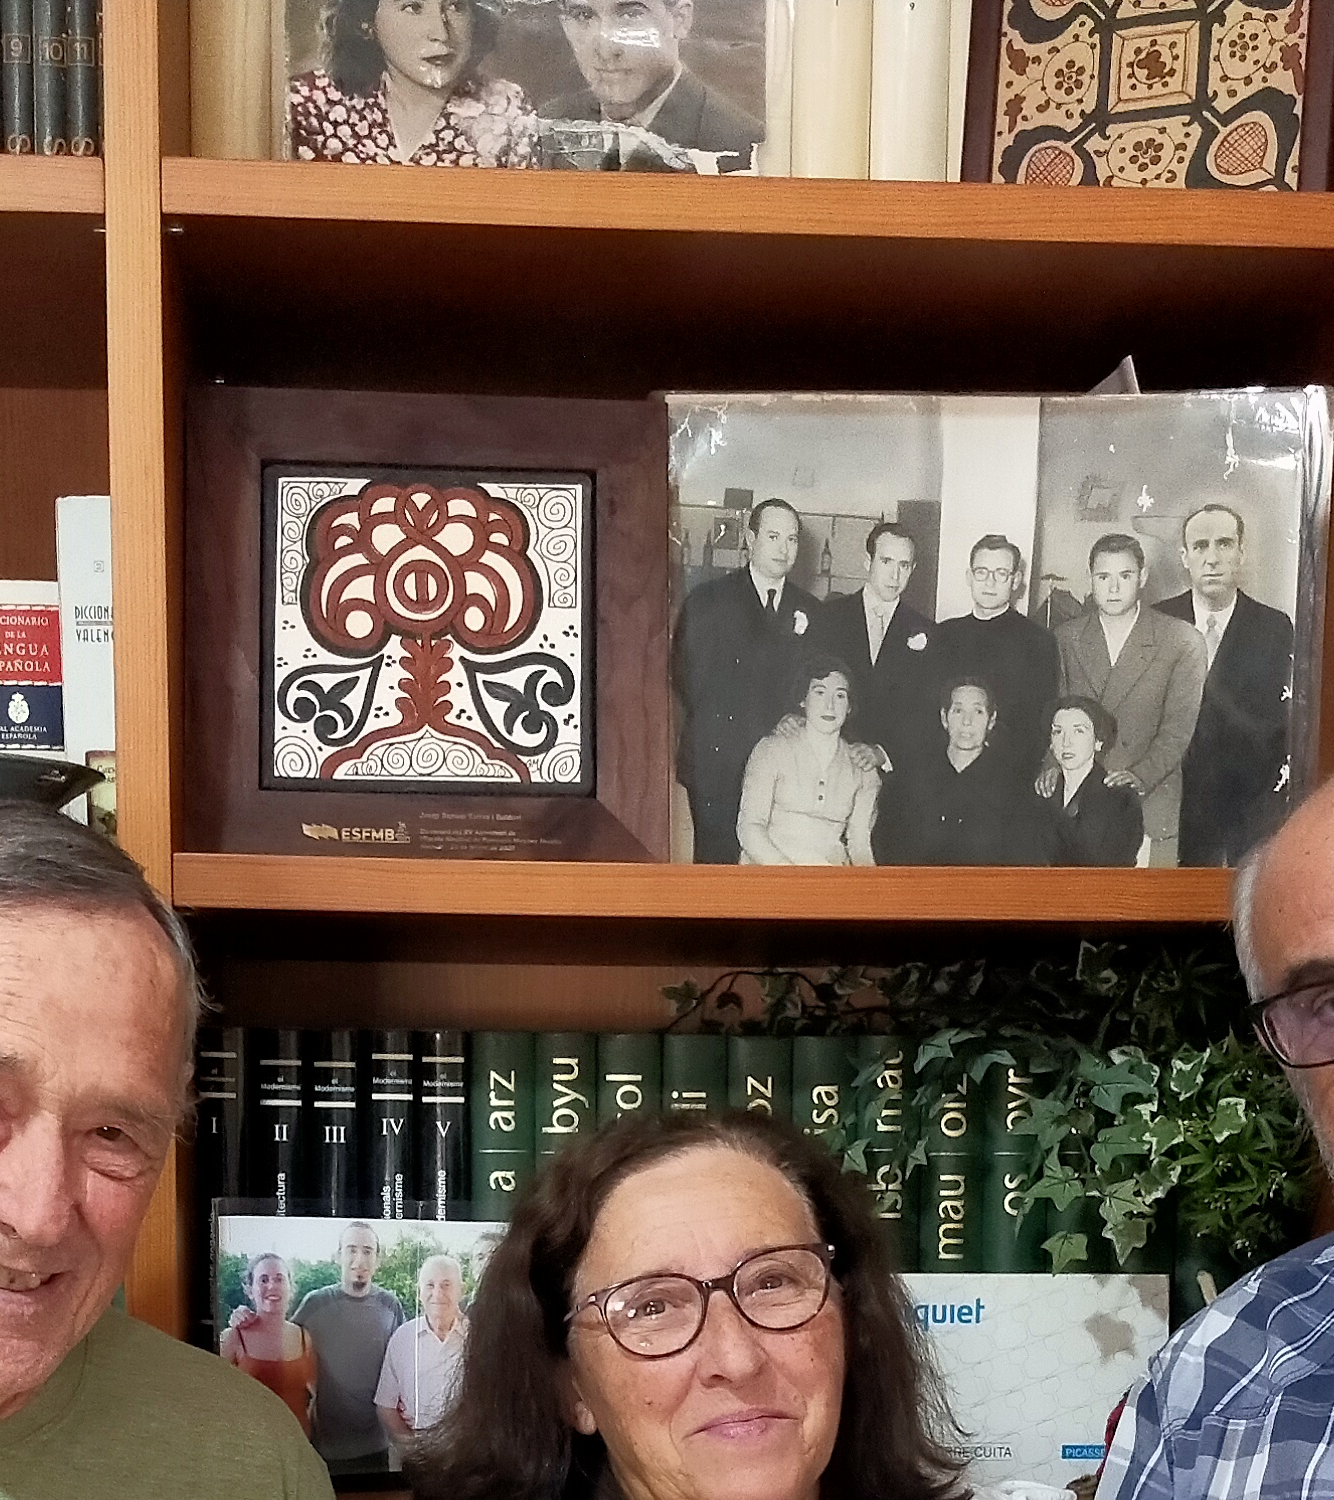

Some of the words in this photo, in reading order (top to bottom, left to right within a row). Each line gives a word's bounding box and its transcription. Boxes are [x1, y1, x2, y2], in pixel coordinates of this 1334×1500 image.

[340, 827, 395, 842] ESFMB
[488, 1069, 517, 1132] arz
[541, 1056, 589, 1134] byu
[273, 1125, 289, 1142] II
[324, 1126, 346, 1144] III
[381, 1117, 405, 1136] IV
[436, 1121, 451, 1138] V
[489, 1170, 517, 1192] a
[938, 1174, 966, 1260] mau
